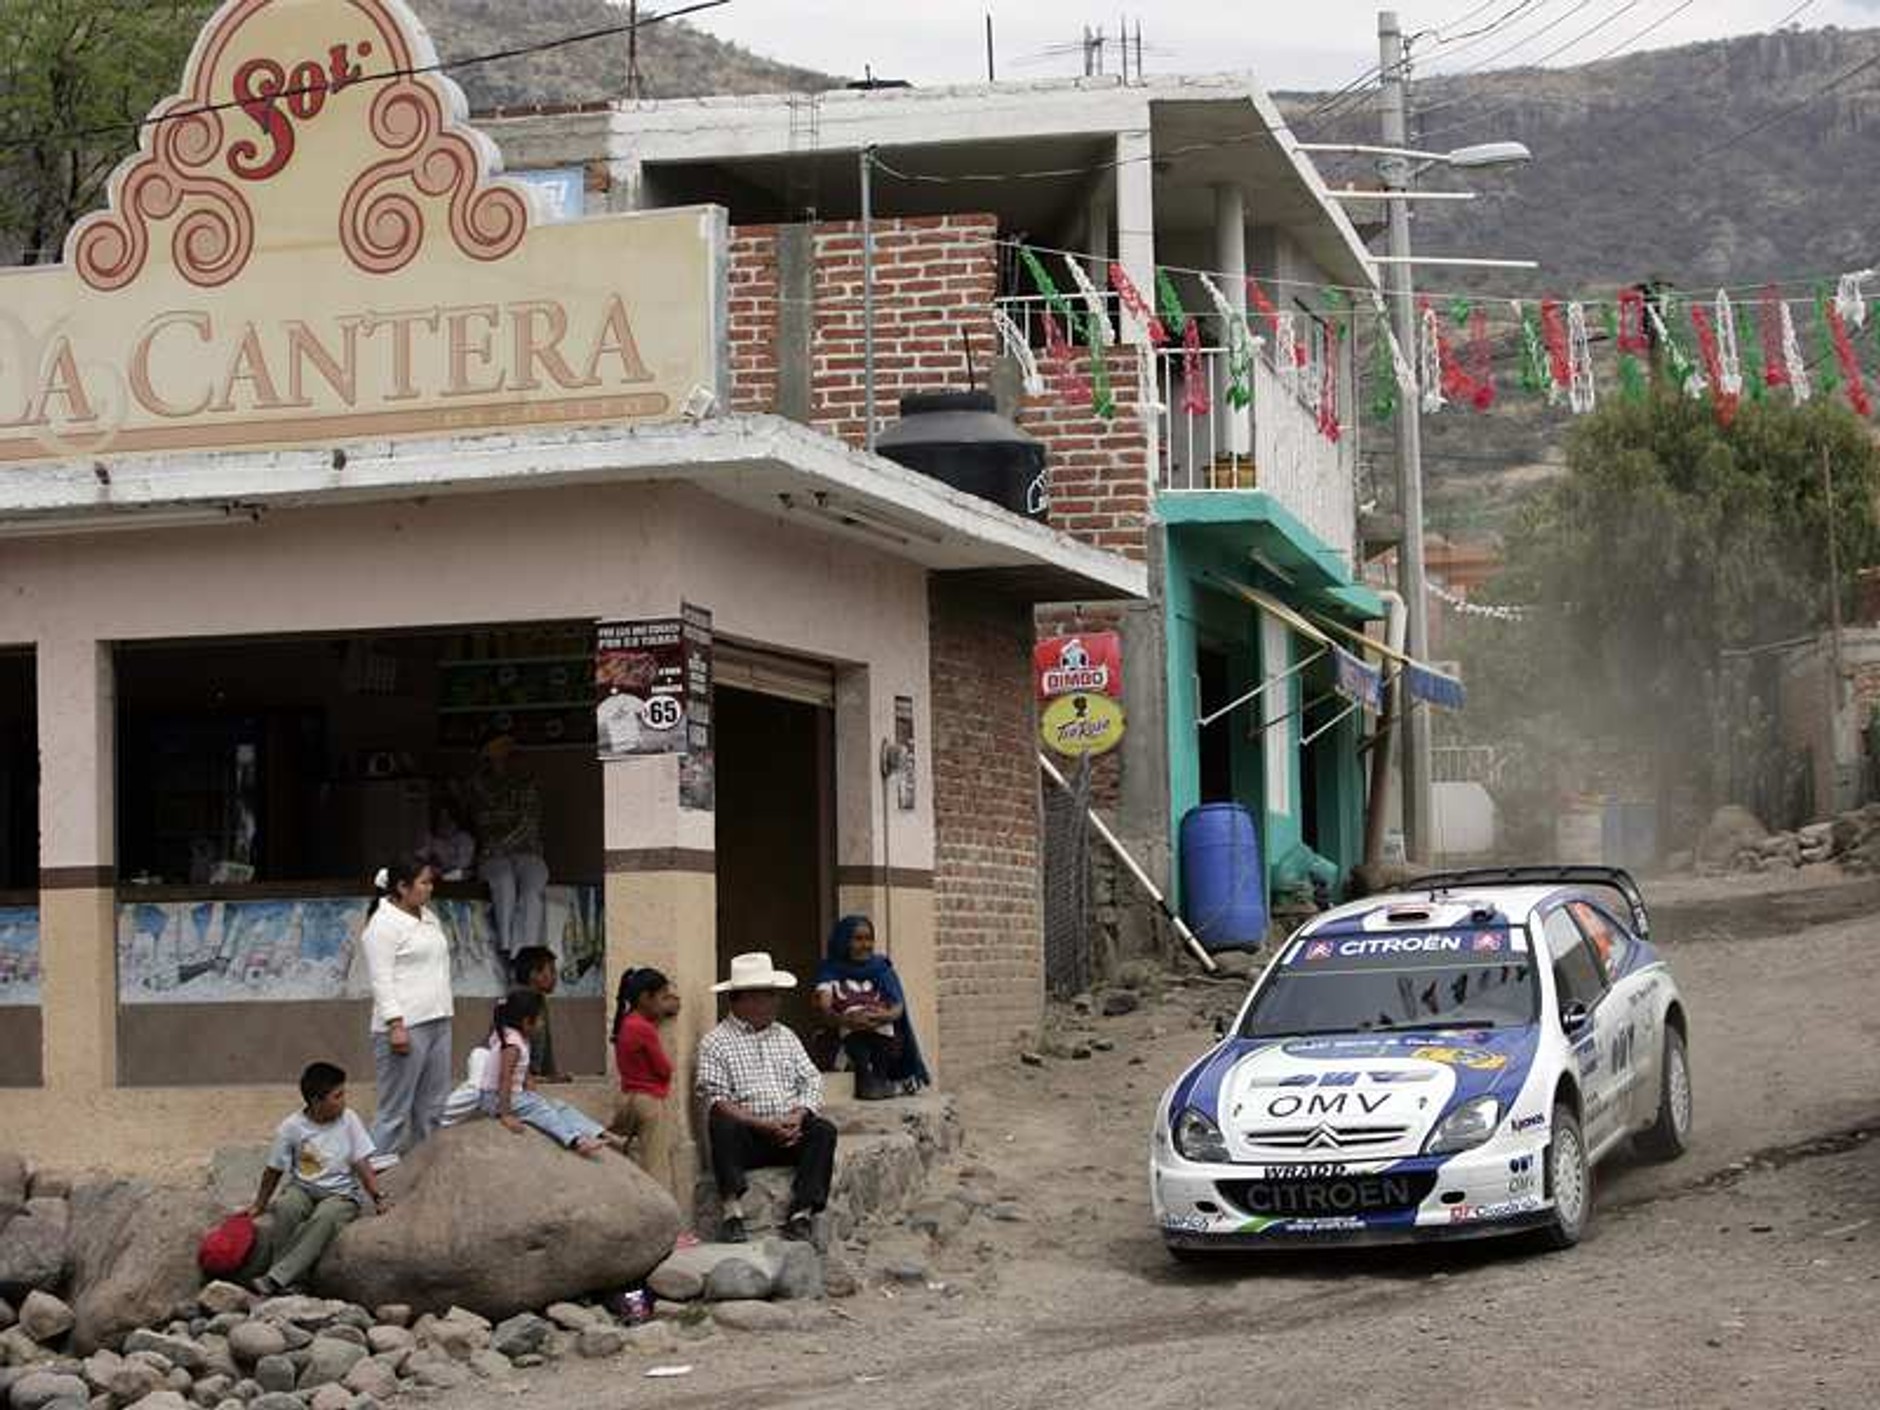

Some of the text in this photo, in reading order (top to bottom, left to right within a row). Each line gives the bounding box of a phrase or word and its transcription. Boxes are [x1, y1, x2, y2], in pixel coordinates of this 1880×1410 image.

[128, 292, 655, 418] CANTERA
[649, 701, 677, 724] 65
[1338, 933, 1461, 956] CITROËN
[1268, 1092, 1392, 1118] OMV
